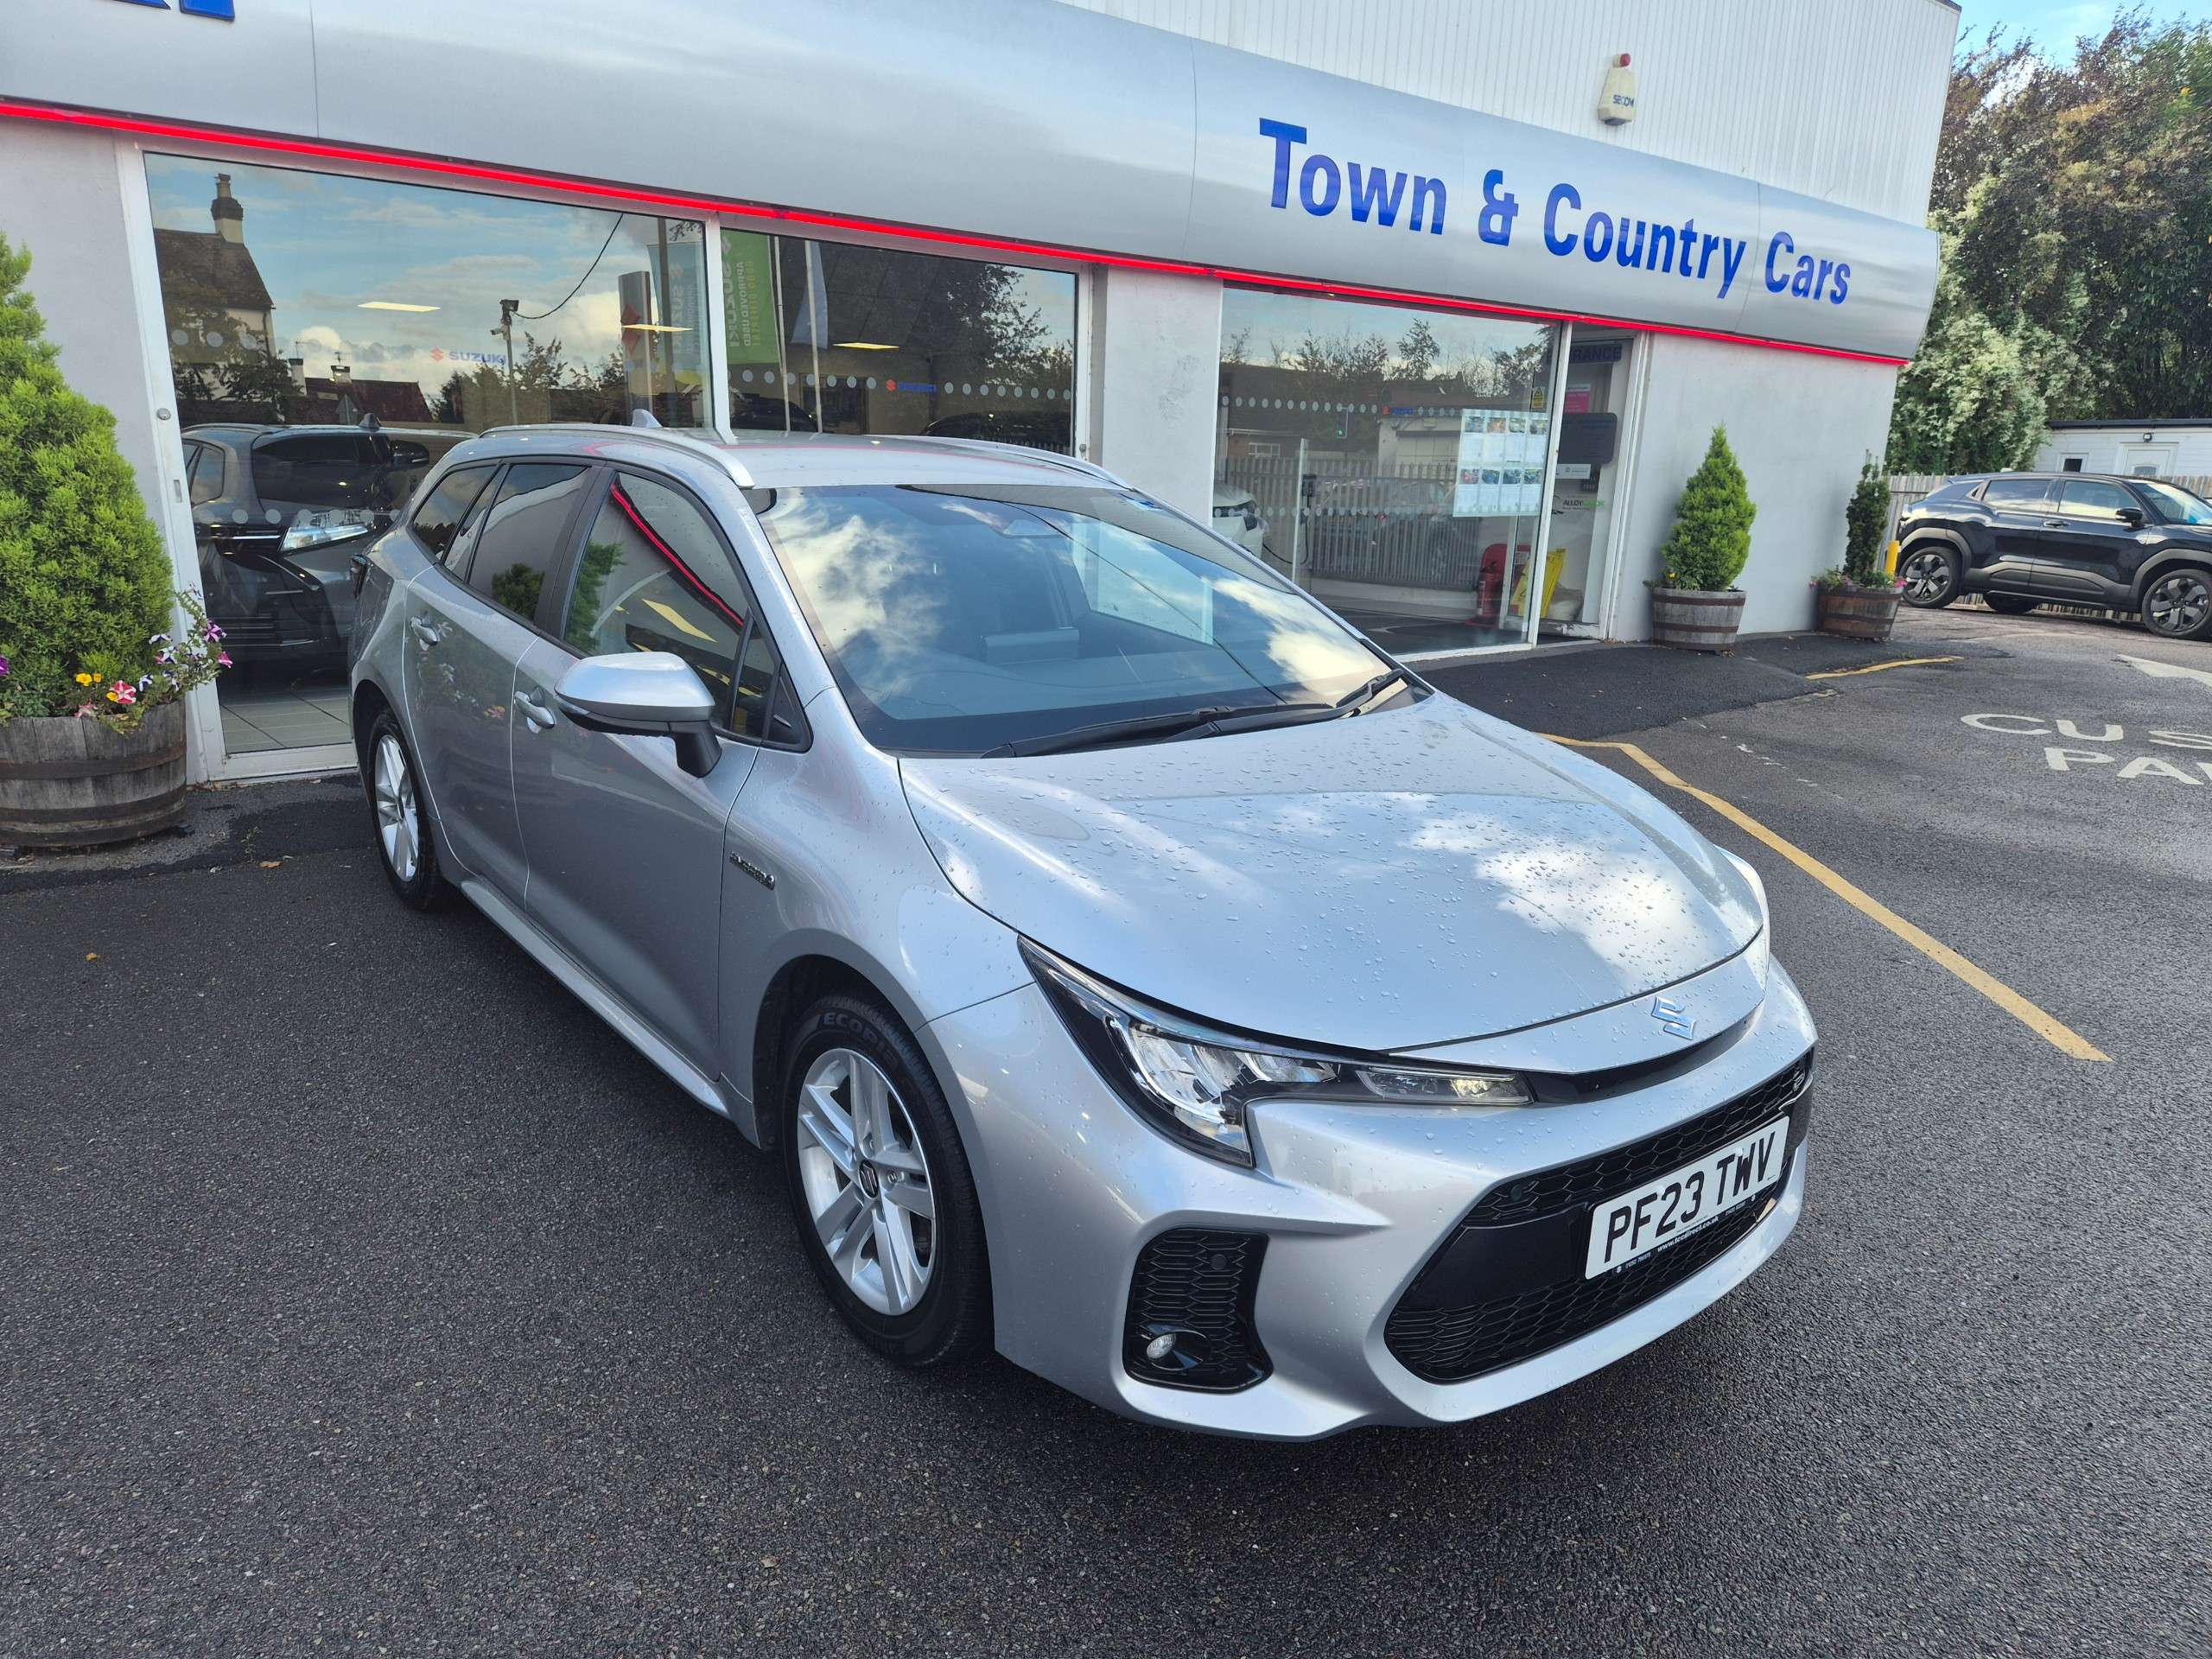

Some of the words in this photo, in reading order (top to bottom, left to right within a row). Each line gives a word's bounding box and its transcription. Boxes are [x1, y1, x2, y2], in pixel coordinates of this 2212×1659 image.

[1259, 118, 1446, 235] Town
[1478, 168, 1519, 246] &
[1543, 183, 1746, 299] Country
[1764, 232, 1851, 305] Cars
[449, 351, 507, 364] SUZUKI
[2044, 747, 2212, 785] PA
[1604, 1170, 1705, 1264] PF23
[1716, 1131, 1776, 1206] TWV
